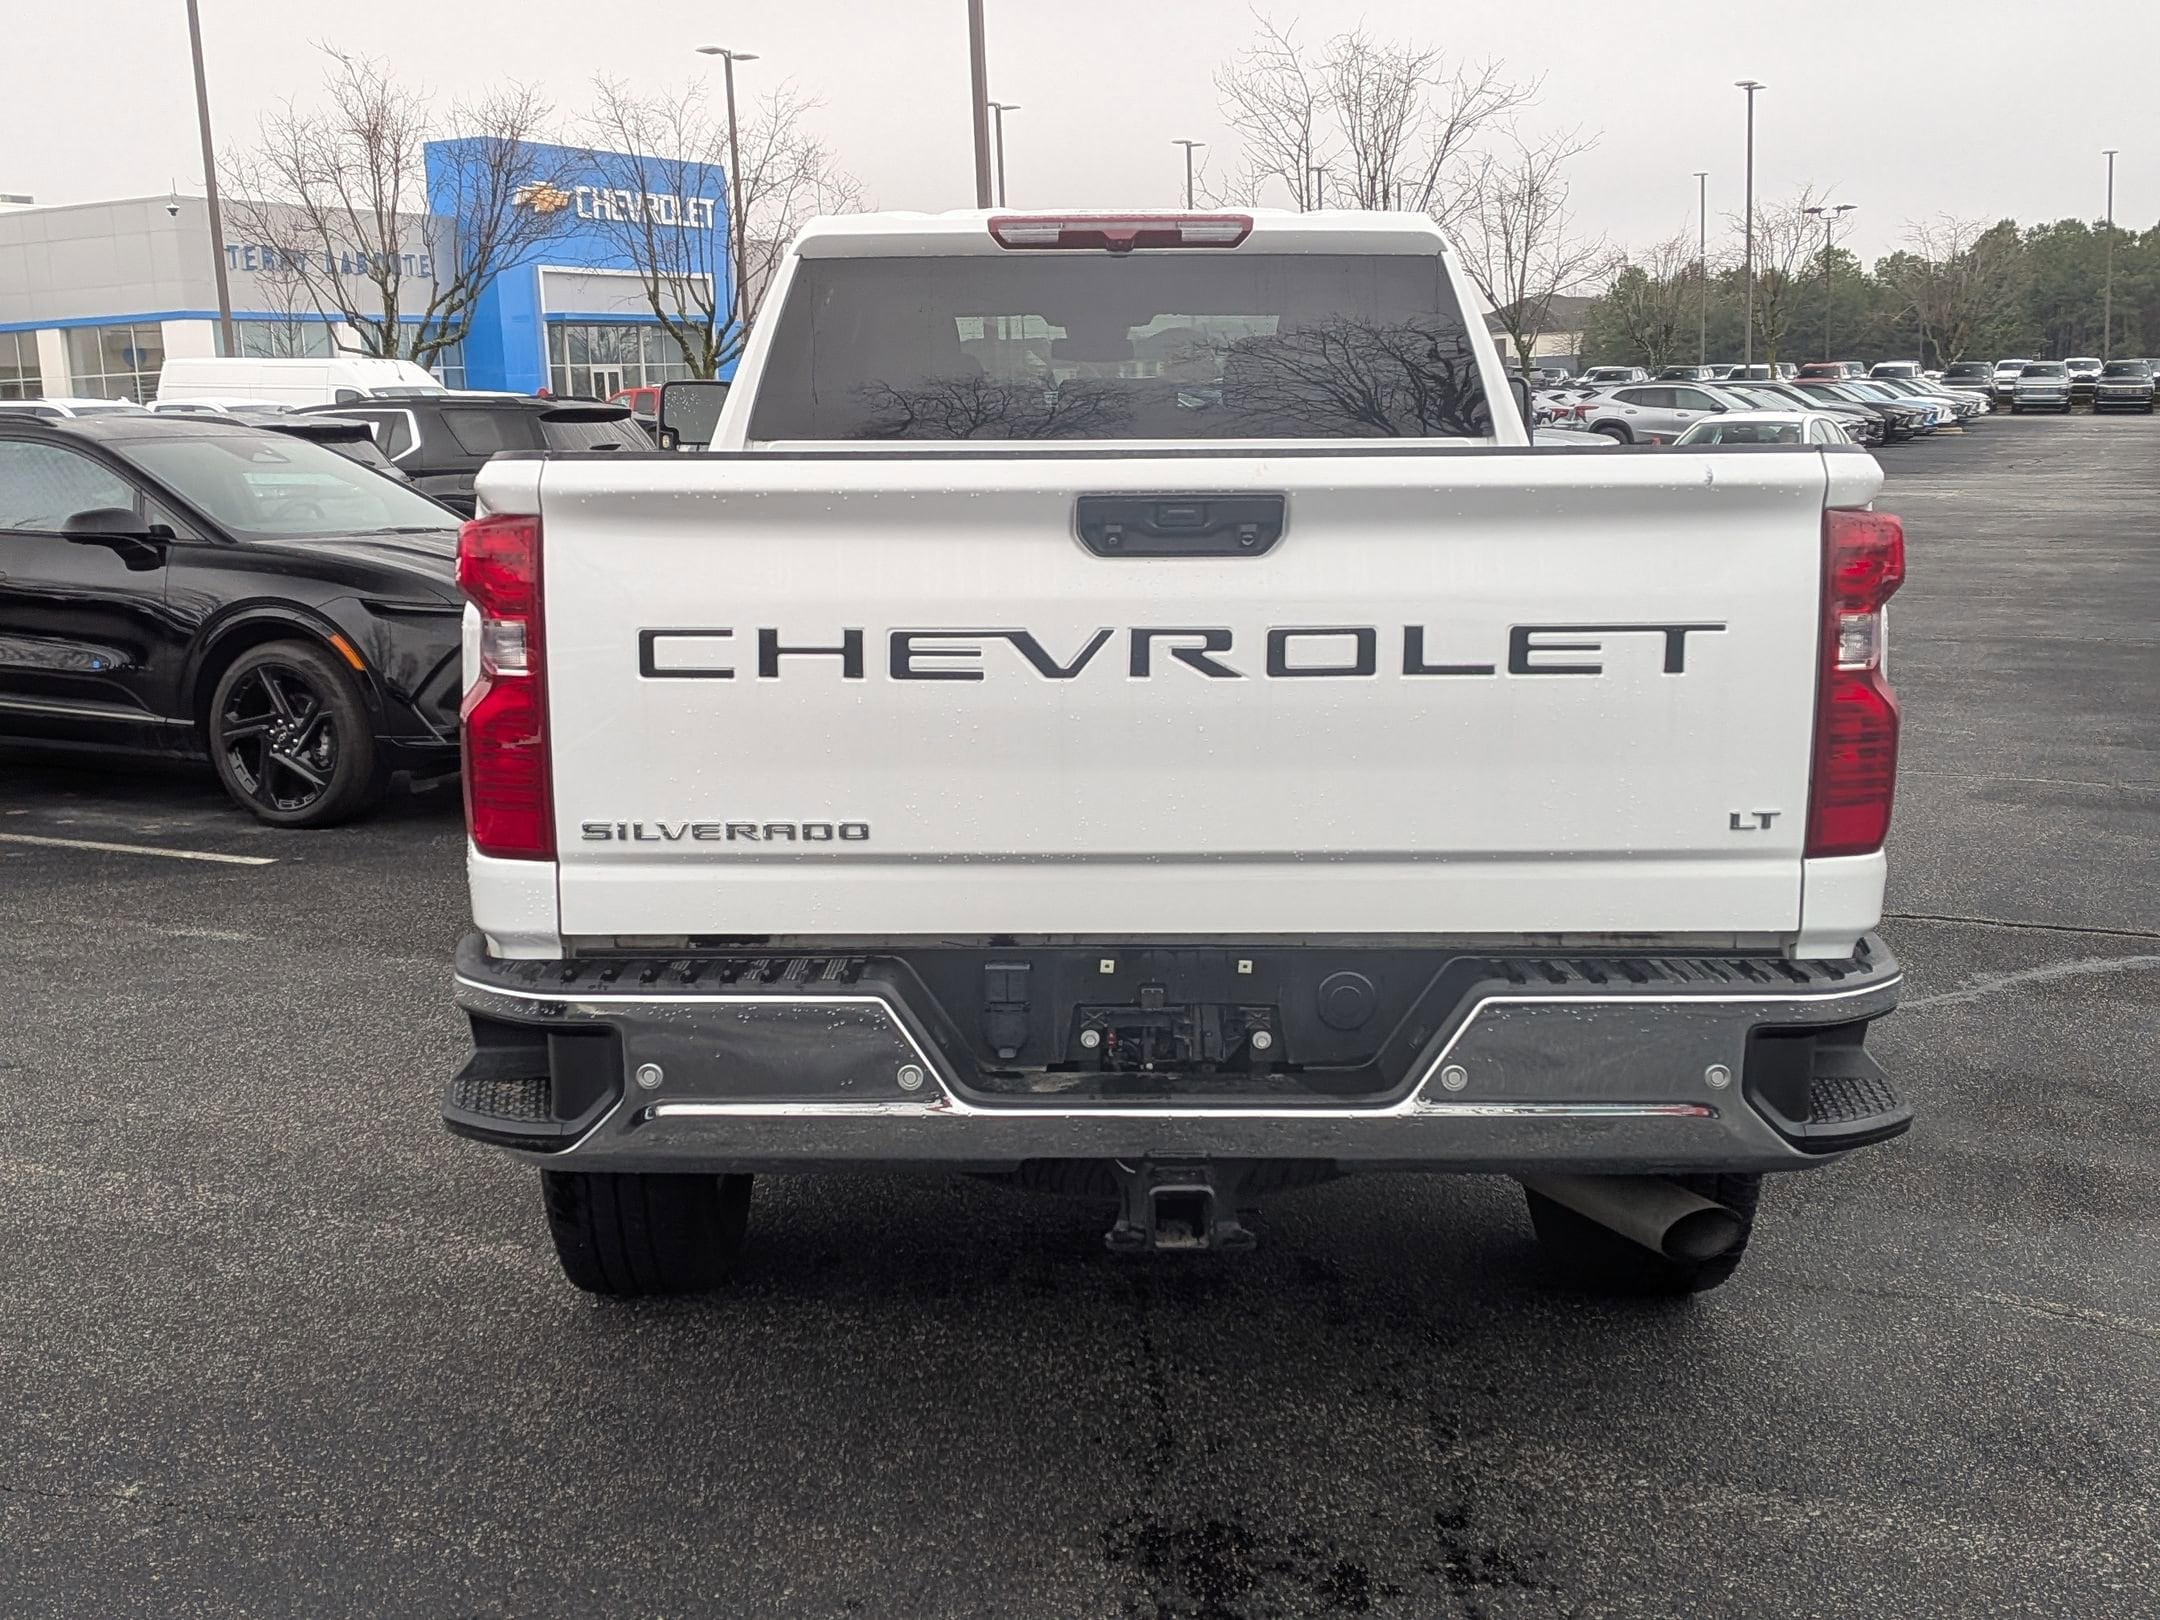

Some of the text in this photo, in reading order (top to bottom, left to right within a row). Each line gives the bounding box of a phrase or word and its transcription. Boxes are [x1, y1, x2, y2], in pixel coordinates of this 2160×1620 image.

[575, 185, 715, 229] CHEVROLET
[324, 249, 433, 279] LABTE
[638, 624, 1727, 681] CHEVROLET
[581, 820, 870, 842] SILVERADO
[1729, 809, 1781, 831] LT
